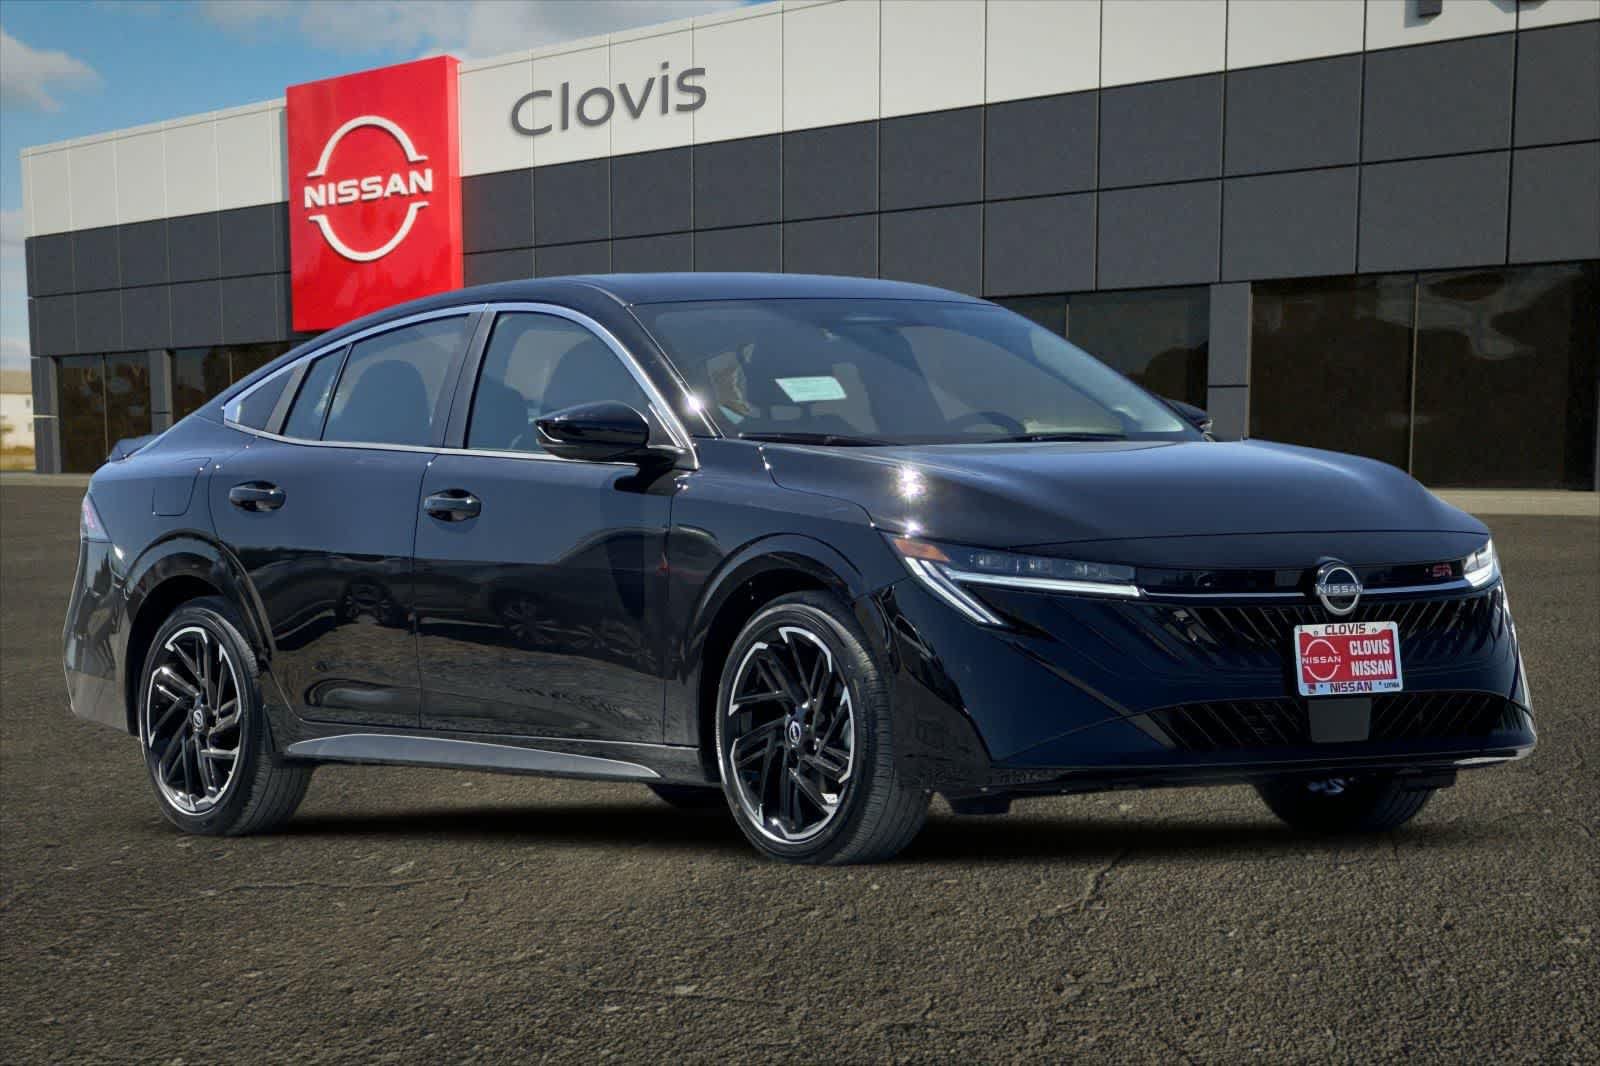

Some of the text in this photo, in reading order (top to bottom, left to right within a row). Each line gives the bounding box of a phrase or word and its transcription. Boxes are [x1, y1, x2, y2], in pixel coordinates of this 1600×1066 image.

[511, 61, 707, 136] Clovis
[304, 168, 433, 208] NISSAN
[1316, 583, 1363, 594] NISSAN
[1325, 623, 1366, 635] CLOVIS
[1349, 639, 1390, 656] CLOVIS
[1302, 656, 1341, 664] NISSAN
[1351, 660, 1393, 676] NISSAN
[1330, 681, 1372, 693] NISSAN
